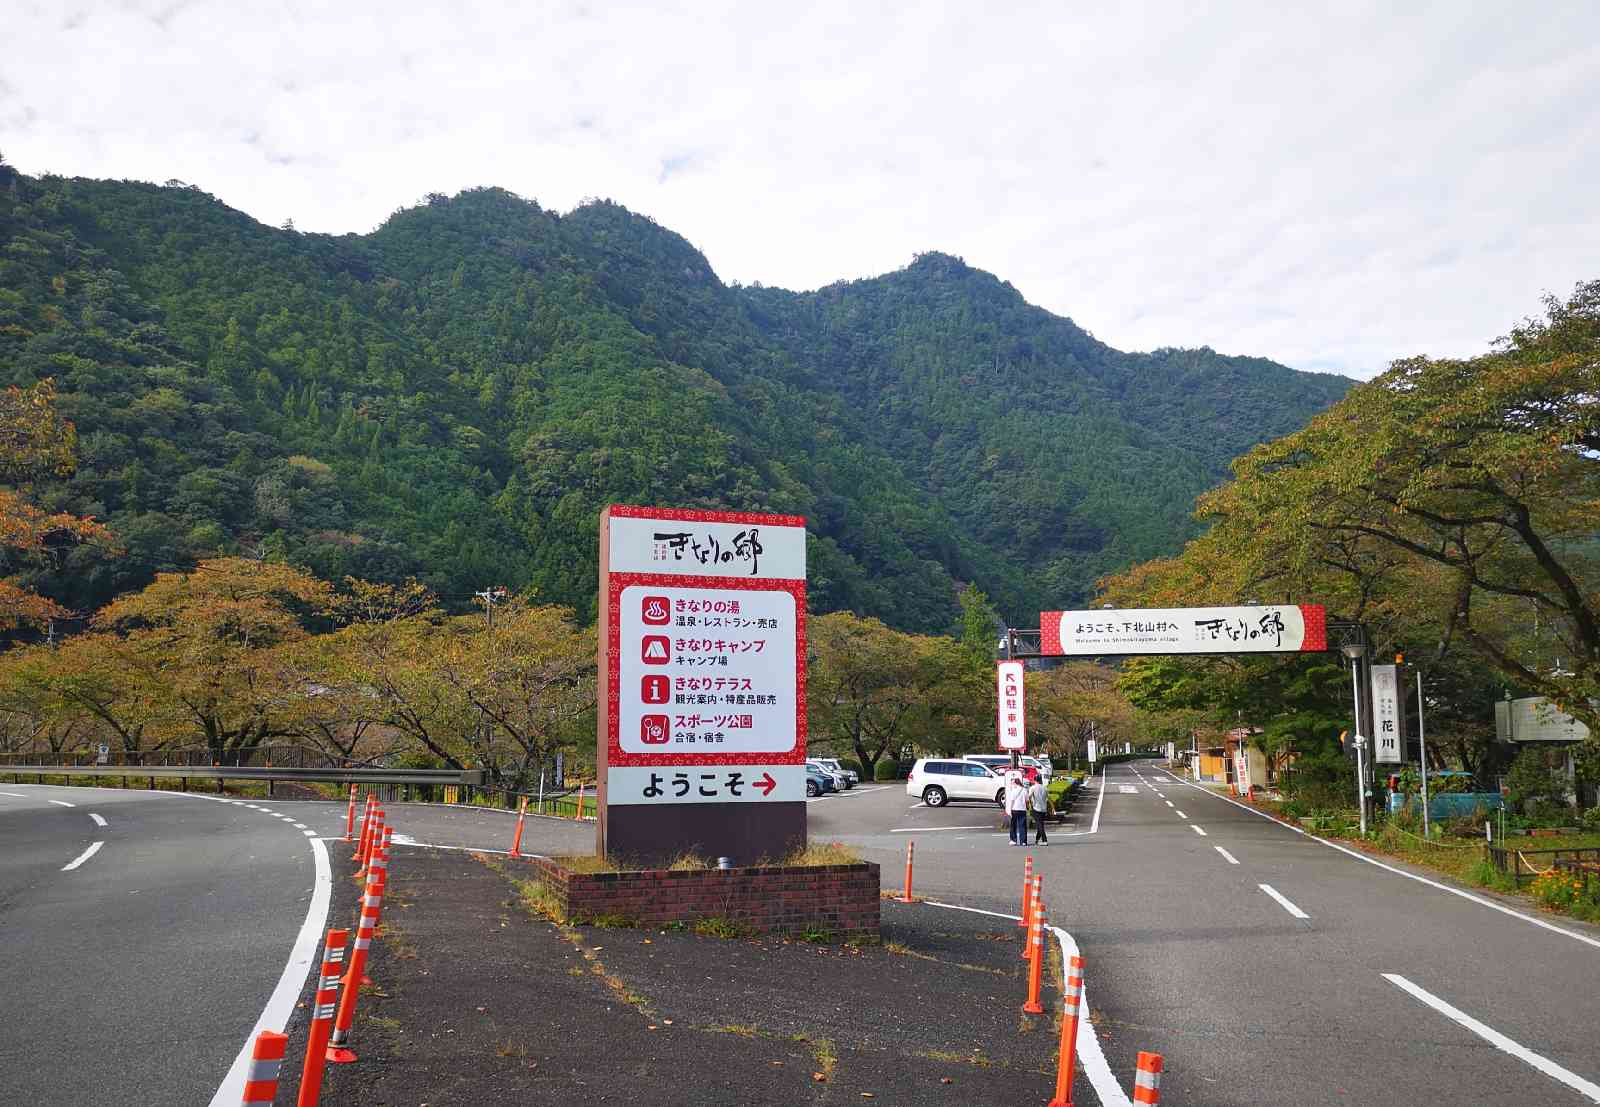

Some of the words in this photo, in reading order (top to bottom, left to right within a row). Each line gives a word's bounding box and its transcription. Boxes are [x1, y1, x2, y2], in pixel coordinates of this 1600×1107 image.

[675, 599, 740, 614] きなりの湯
[675, 616, 777, 629] 温泉・レストラン・売店
[675, 639, 766, 654] きなりキャンプ
[675, 656, 728, 666] キャンプ場
[675, 677, 752, 691] きなりテラス
[675, 694, 777, 705] 観光案内・特産品販売
[674, 714, 753, 729] スポーツ公園
[674, 732, 725, 743] 合宿・宿舎
[1382, 720, 1394, 750] 花川
[642, 773, 745, 797] ようこそ
